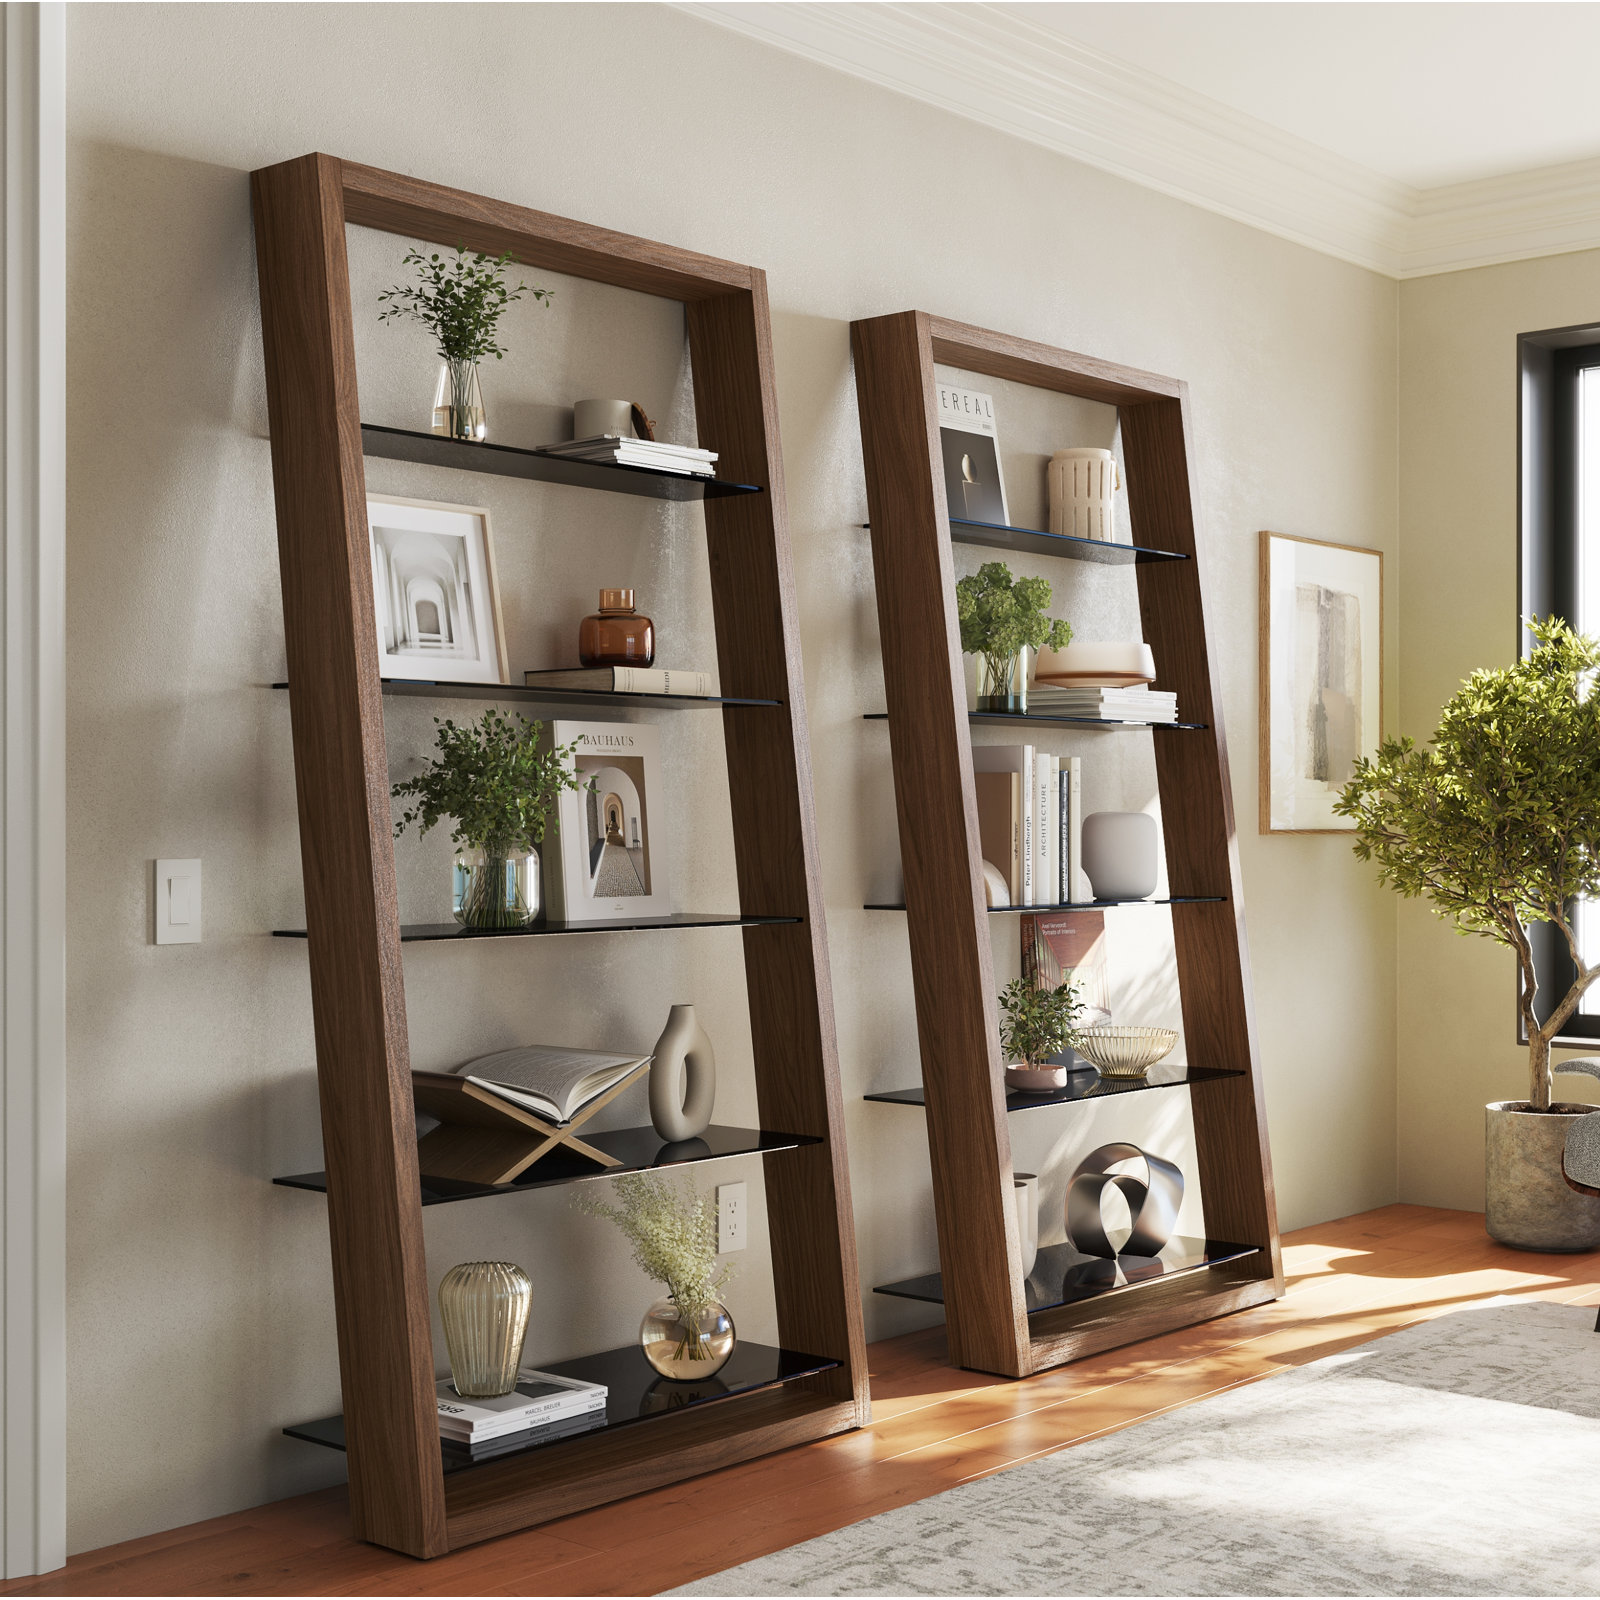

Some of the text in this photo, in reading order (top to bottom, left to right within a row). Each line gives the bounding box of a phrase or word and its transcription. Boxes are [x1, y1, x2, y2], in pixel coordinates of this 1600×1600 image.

[940, 390, 992, 418] EREAL
[583, 734, 634, 747] BAUHAUS
[590, 1391, 605, 1399] TASCHEN
[437, 1403, 465, 1414] BRE
[525, 1402, 561, 1416] MARCEL BREUER
[587, 1402, 603, 1410] TASCHEN
[529, 1416, 550, 1425] BAUHAUS
